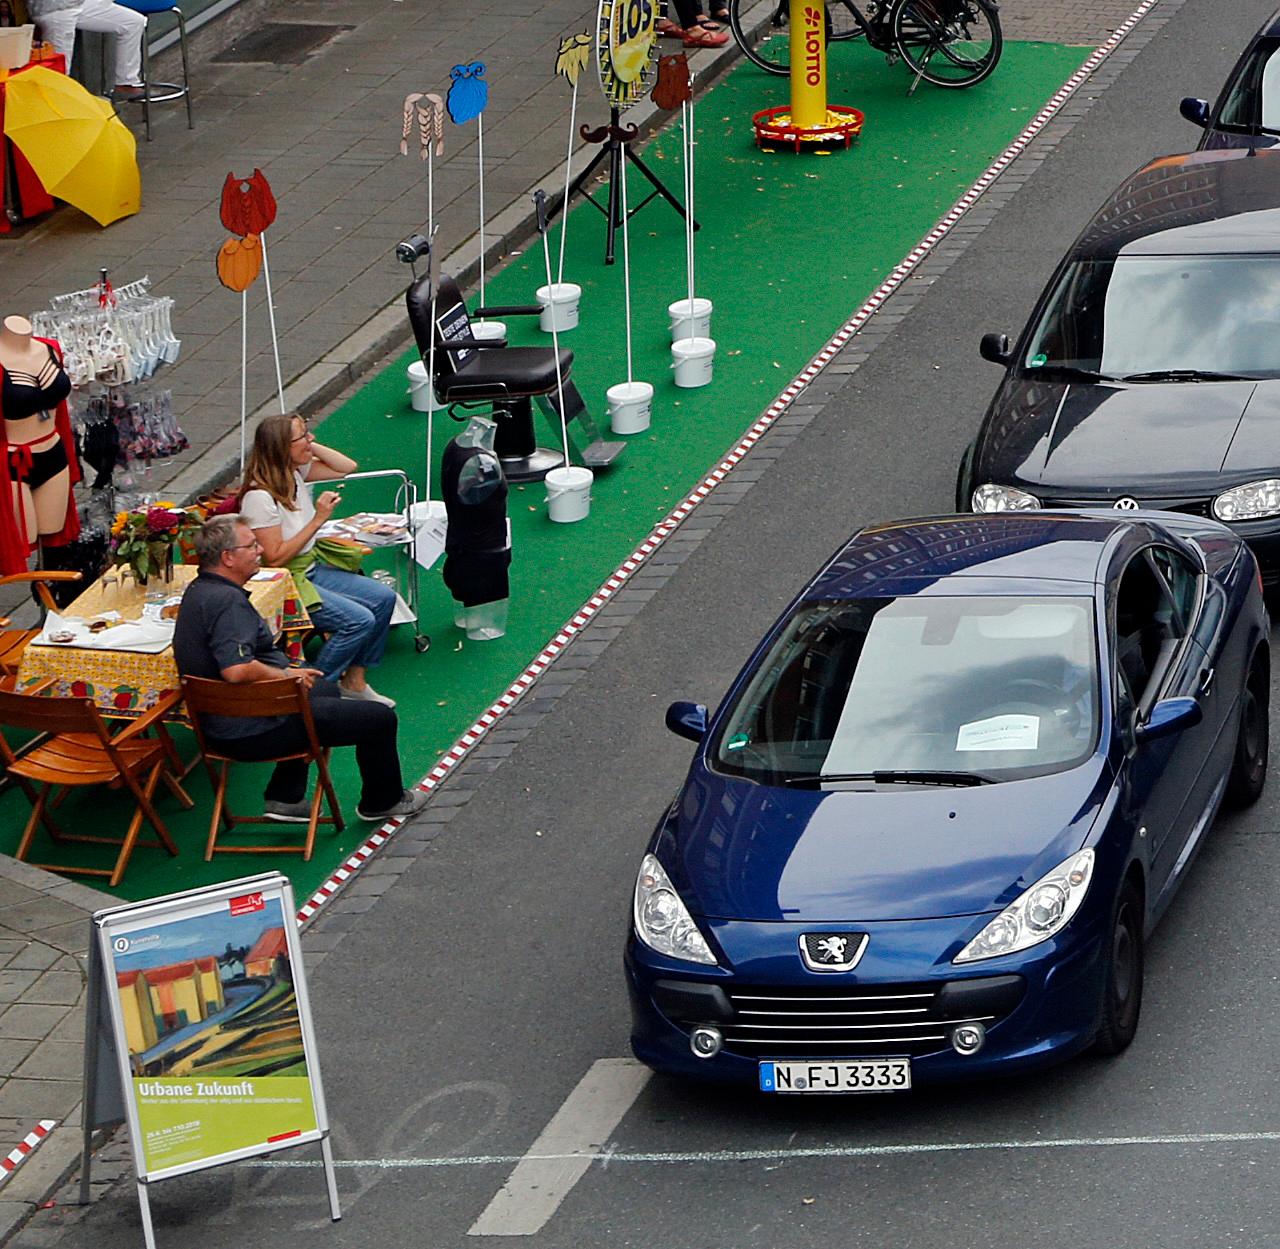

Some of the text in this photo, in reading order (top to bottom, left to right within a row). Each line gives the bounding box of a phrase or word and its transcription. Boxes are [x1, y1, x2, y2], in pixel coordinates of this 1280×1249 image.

[805, 30, 820, 87] LOTTO
[776, 1067, 792, 1088] N
[808, 1066, 839, 1088] FJ
[846, 1065, 906, 1087] 3333
[139, 1081, 254, 1096] Urbane Zukunft
